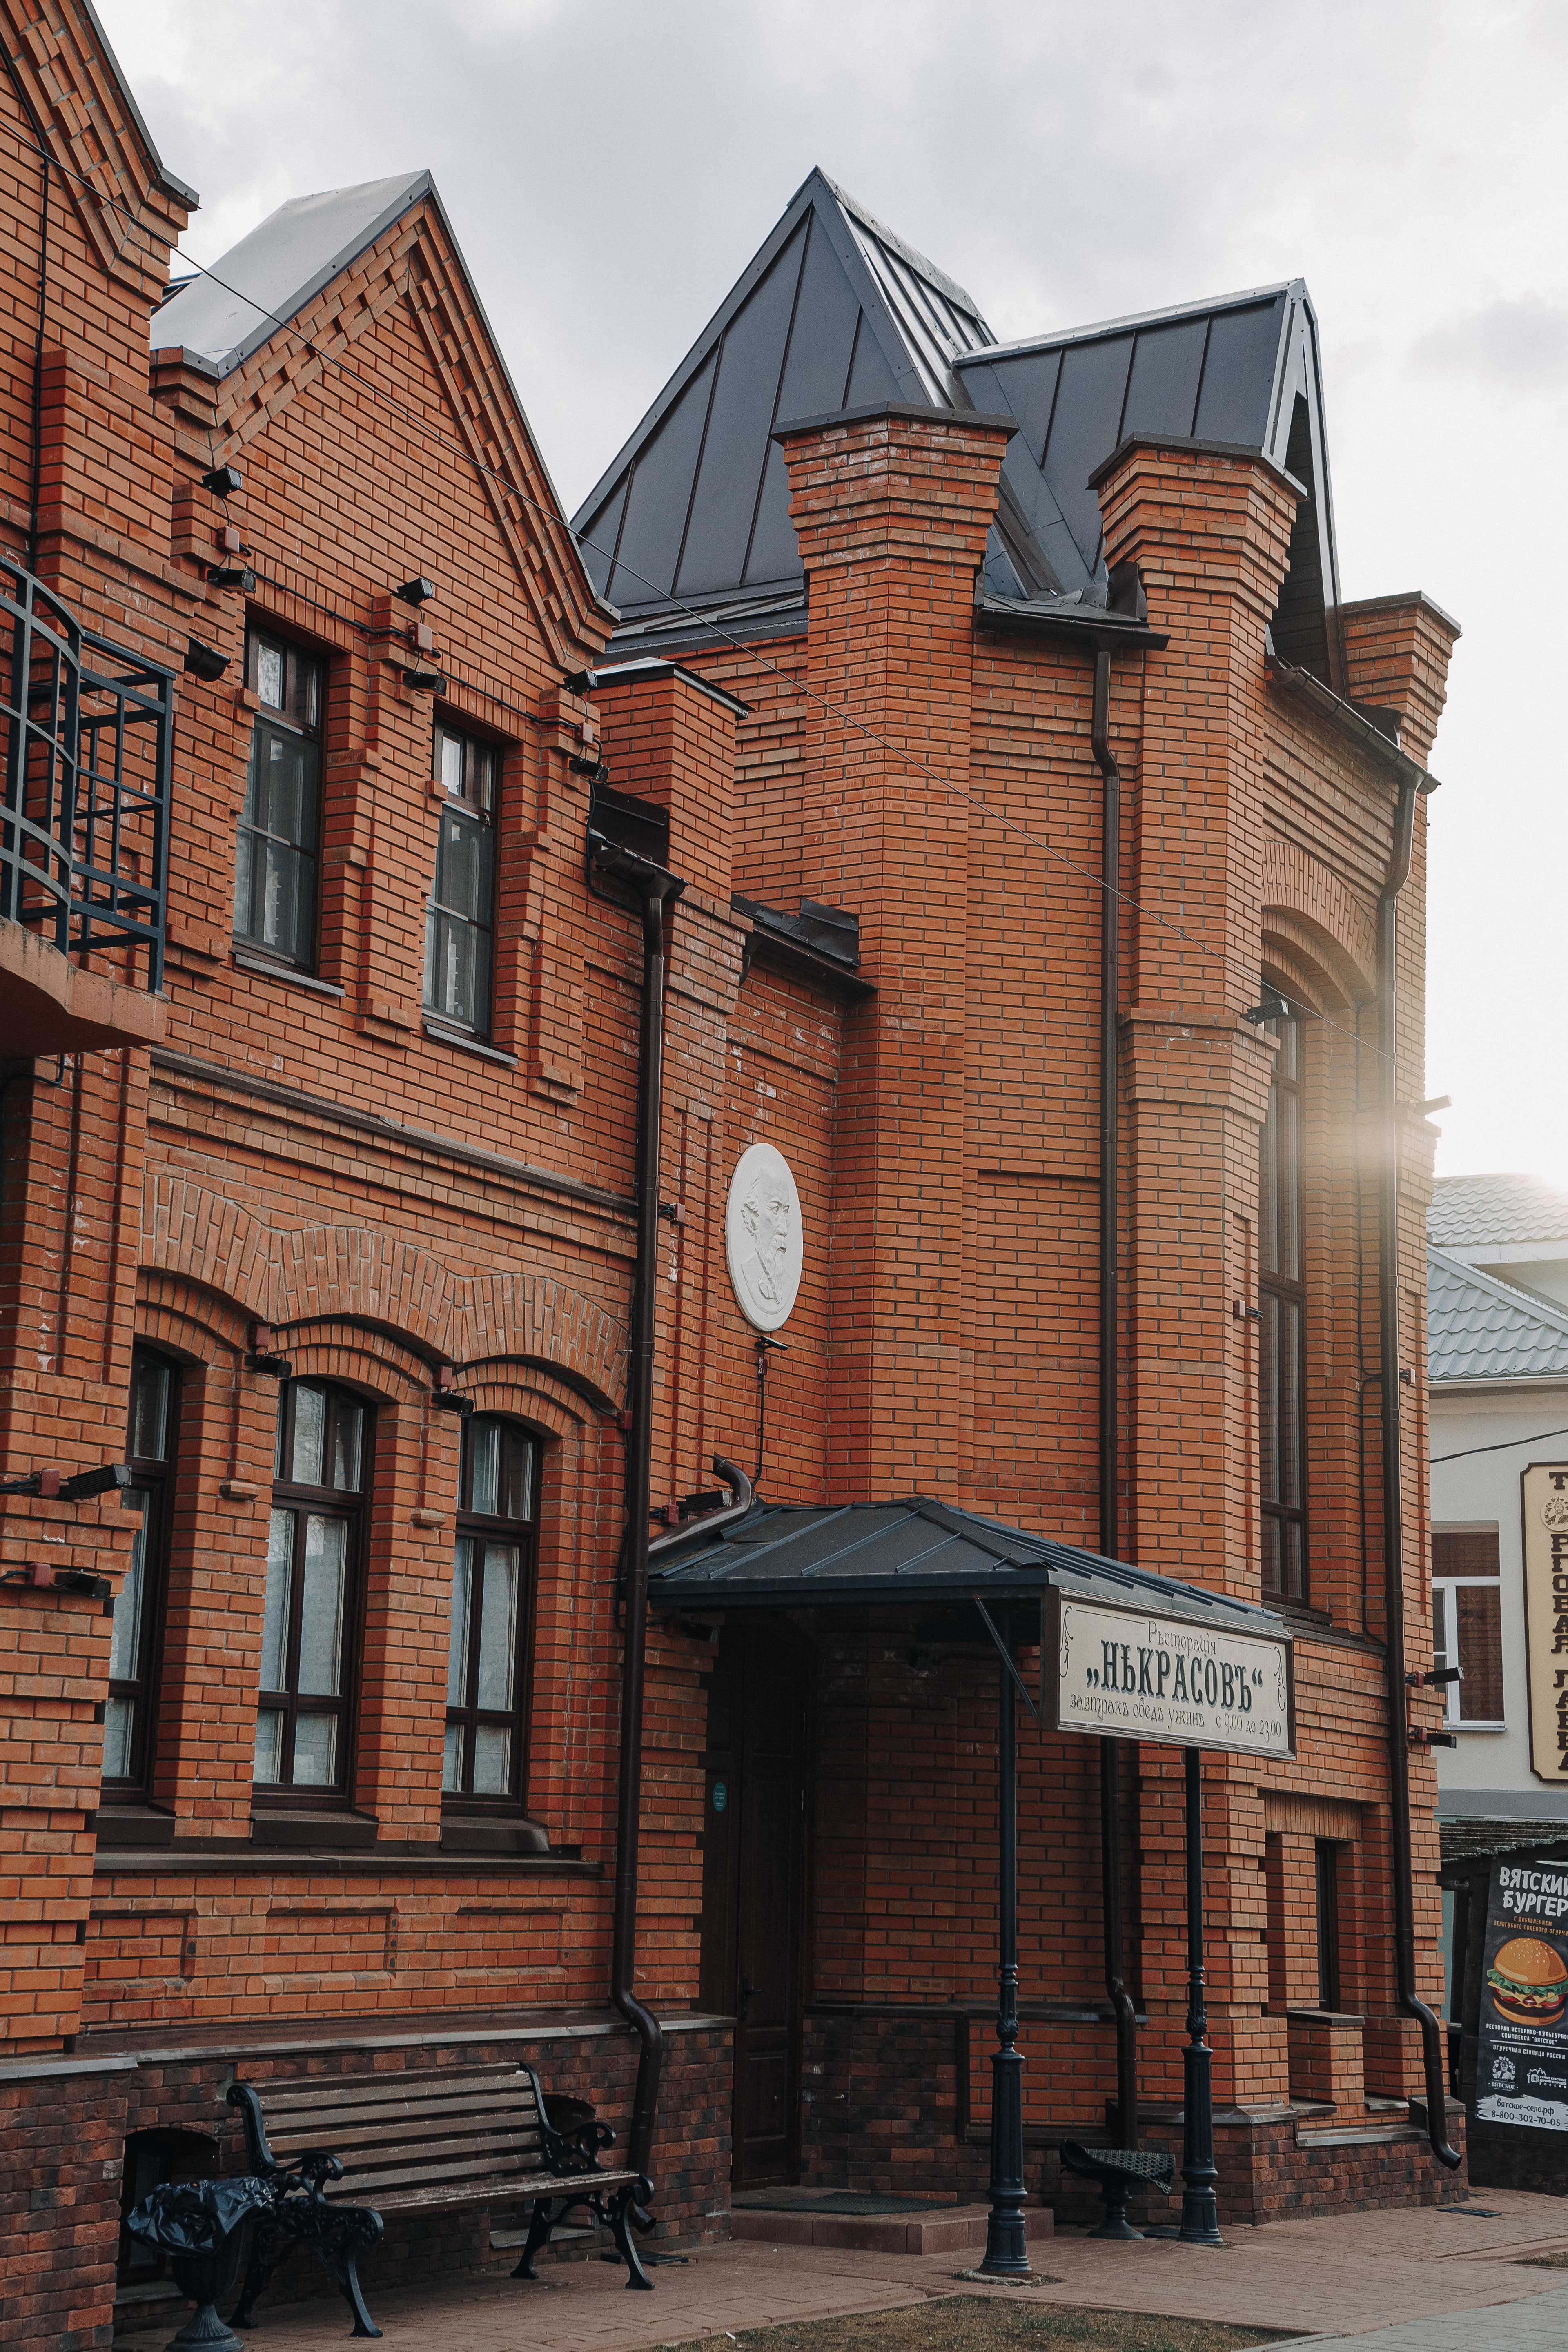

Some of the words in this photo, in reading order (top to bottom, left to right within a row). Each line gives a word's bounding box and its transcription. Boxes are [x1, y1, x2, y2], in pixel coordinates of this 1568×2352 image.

[1069, 1694, 1129, 1722] завтракъ
[1133, 1697, 1164, 1723] обедъ
[1168, 1708, 1205, 1731] ужинъ
[1224, 1713, 1243, 1735] 9.00
[1246, 1720, 1256, 1735] до
[1259, 1719, 1281, 1744] 23.00
[1503, 1890, 1568, 1917] БУРГЕР
[1494, 1920, 1522, 1929] БЕЛОГУБОГО
[1523, 1924, 1548, 1933] СОЛЕНОГО
[1518, 1916, 1552, 1926] ДОБАВЛЕНИЕМ
[1486, 2023, 1510, 2031] РЕСТОРАН
[1511, 2027, 1568, 2040] ИСТОРИКО-КУЛЬТУРНО
[1501, 2032, 1530, 2041] КОМПЛЕКСА
[1532, 2036, 1557, 2045] "ВЯТСКОЕ"
[1493, 2044, 1521, 2054] ОГУРЕЧНАЯ
[1523, 2048, 1545, 2057] СТОЛИЦА
[1491, 2082, 1516, 2090] ВЯТСКОЕ
[1497, 2098, 1555, 2117] вятское-село.рф
[1491, 2110, 1561, 2127] 8-800-302-70-05
